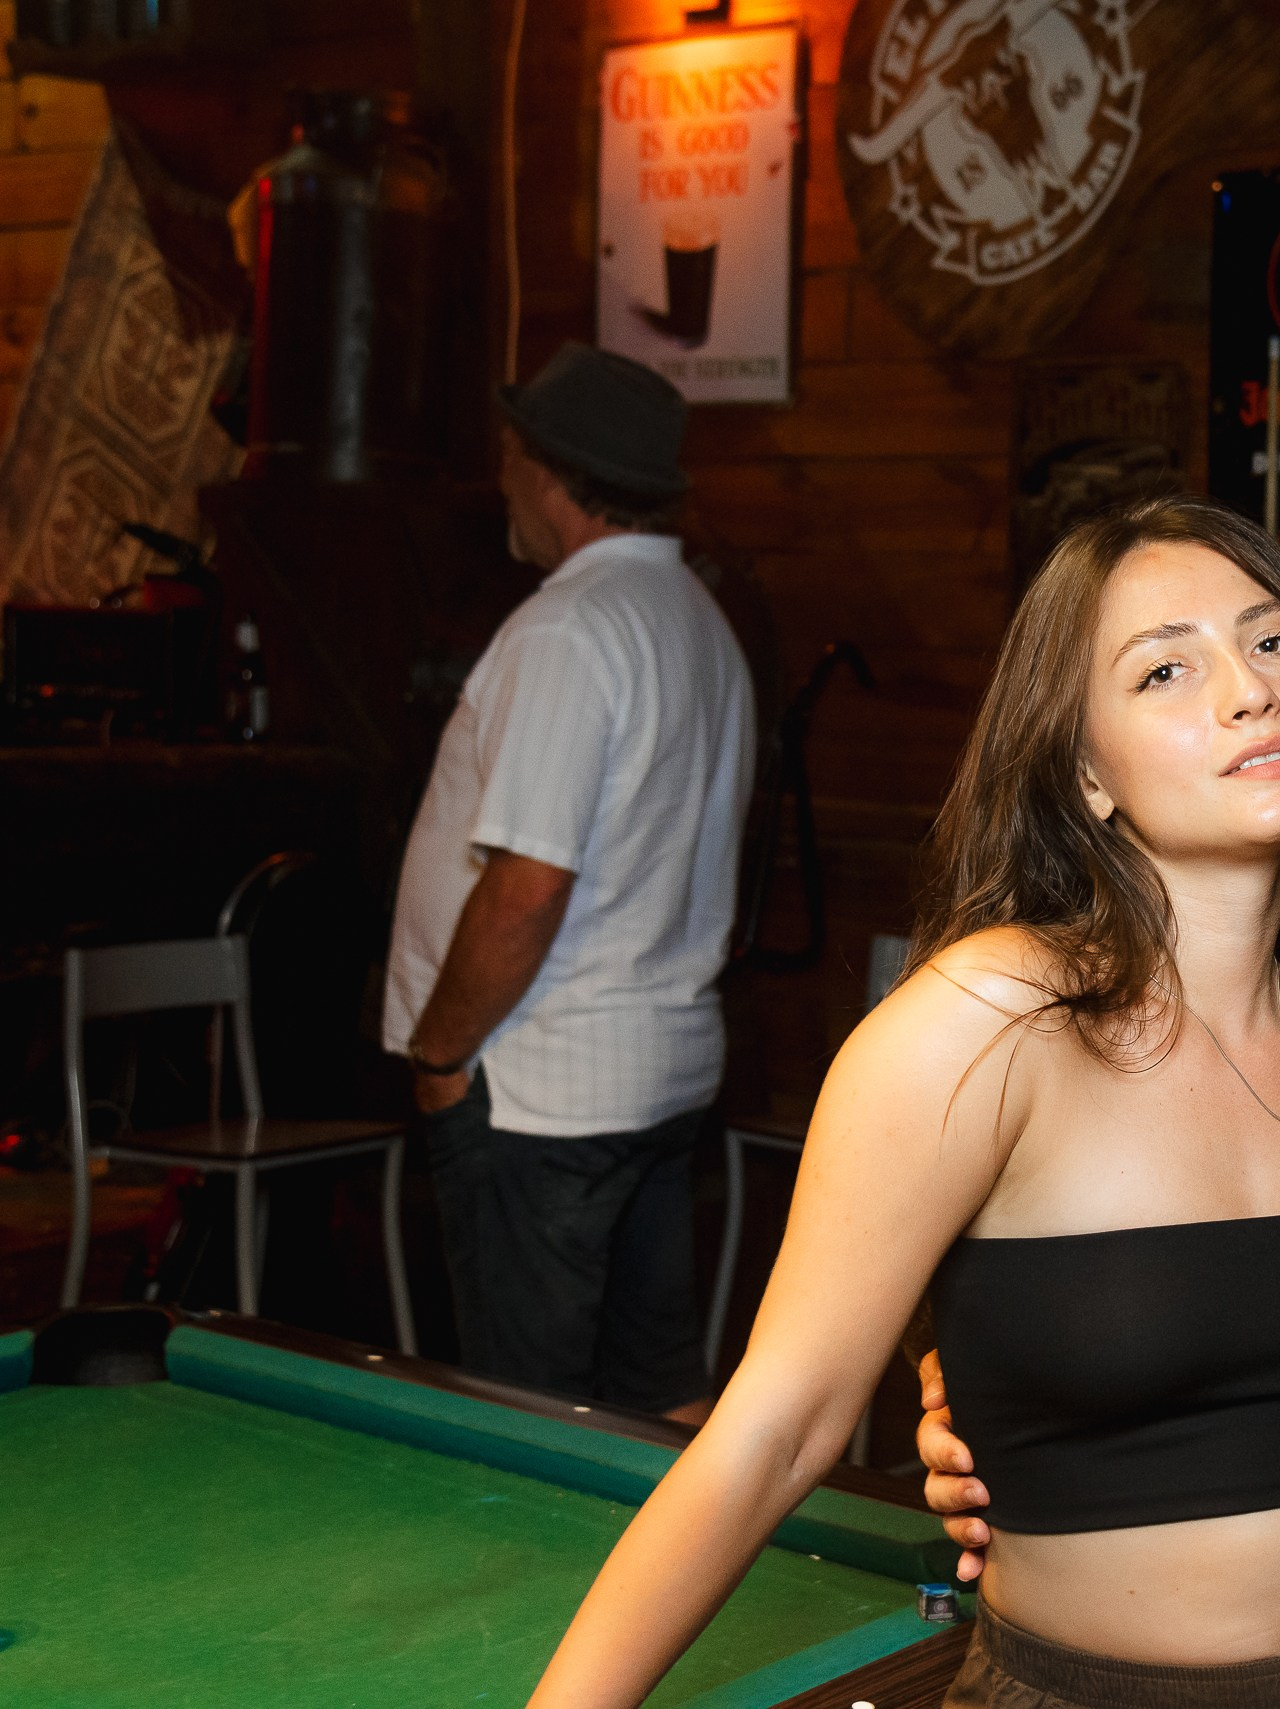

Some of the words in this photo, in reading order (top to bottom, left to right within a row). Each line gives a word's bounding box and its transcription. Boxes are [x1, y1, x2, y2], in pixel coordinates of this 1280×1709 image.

[611, 62, 780, 123] GUINNESS
[639, 128, 664, 160] IS
[677, 120, 750, 157] GOOD
[639, 168, 689, 203] FOR
[695, 159, 750, 198] YOU
